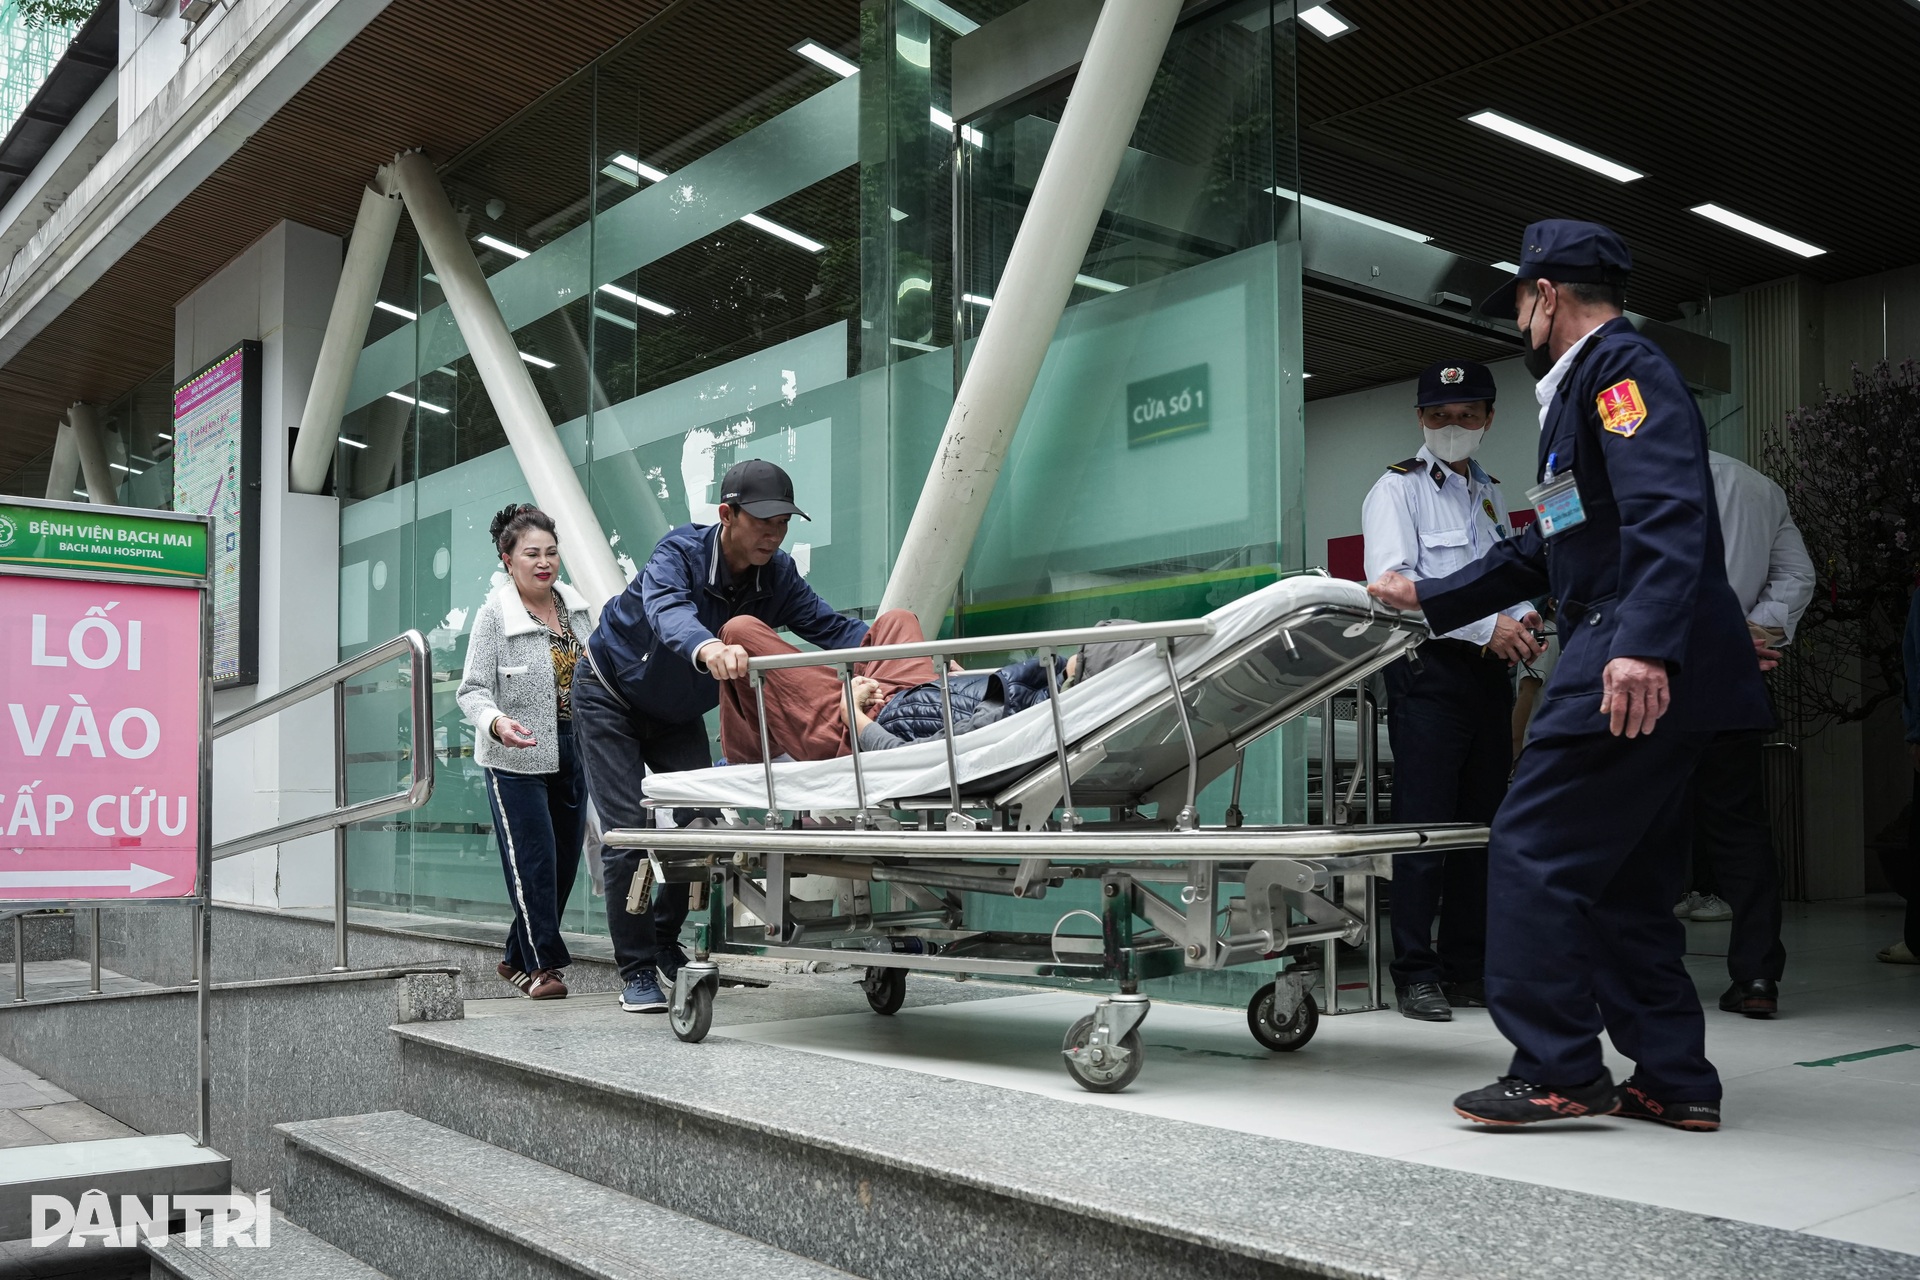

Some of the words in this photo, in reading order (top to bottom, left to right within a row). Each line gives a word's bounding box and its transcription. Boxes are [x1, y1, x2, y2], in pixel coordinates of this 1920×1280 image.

[1169, 386, 1192, 416] SỐ
[1195, 390, 1203, 408] 1
[29, 520, 73, 538] BỆNH
[76, 525, 114, 543] VIỆN
[117, 529, 159, 546] BẠCH
[163, 533, 192, 547] MAI
[59, 542, 90, 553] BACH
[91, 544, 112, 555] MAI
[113, 547, 164, 559] HOSPITAL
[31, 601, 142, 671] LỐI
[8, 694, 161, 759] VÀO
[0, 780, 74, 836] ẤP
[87, 786, 188, 837] CỨU
